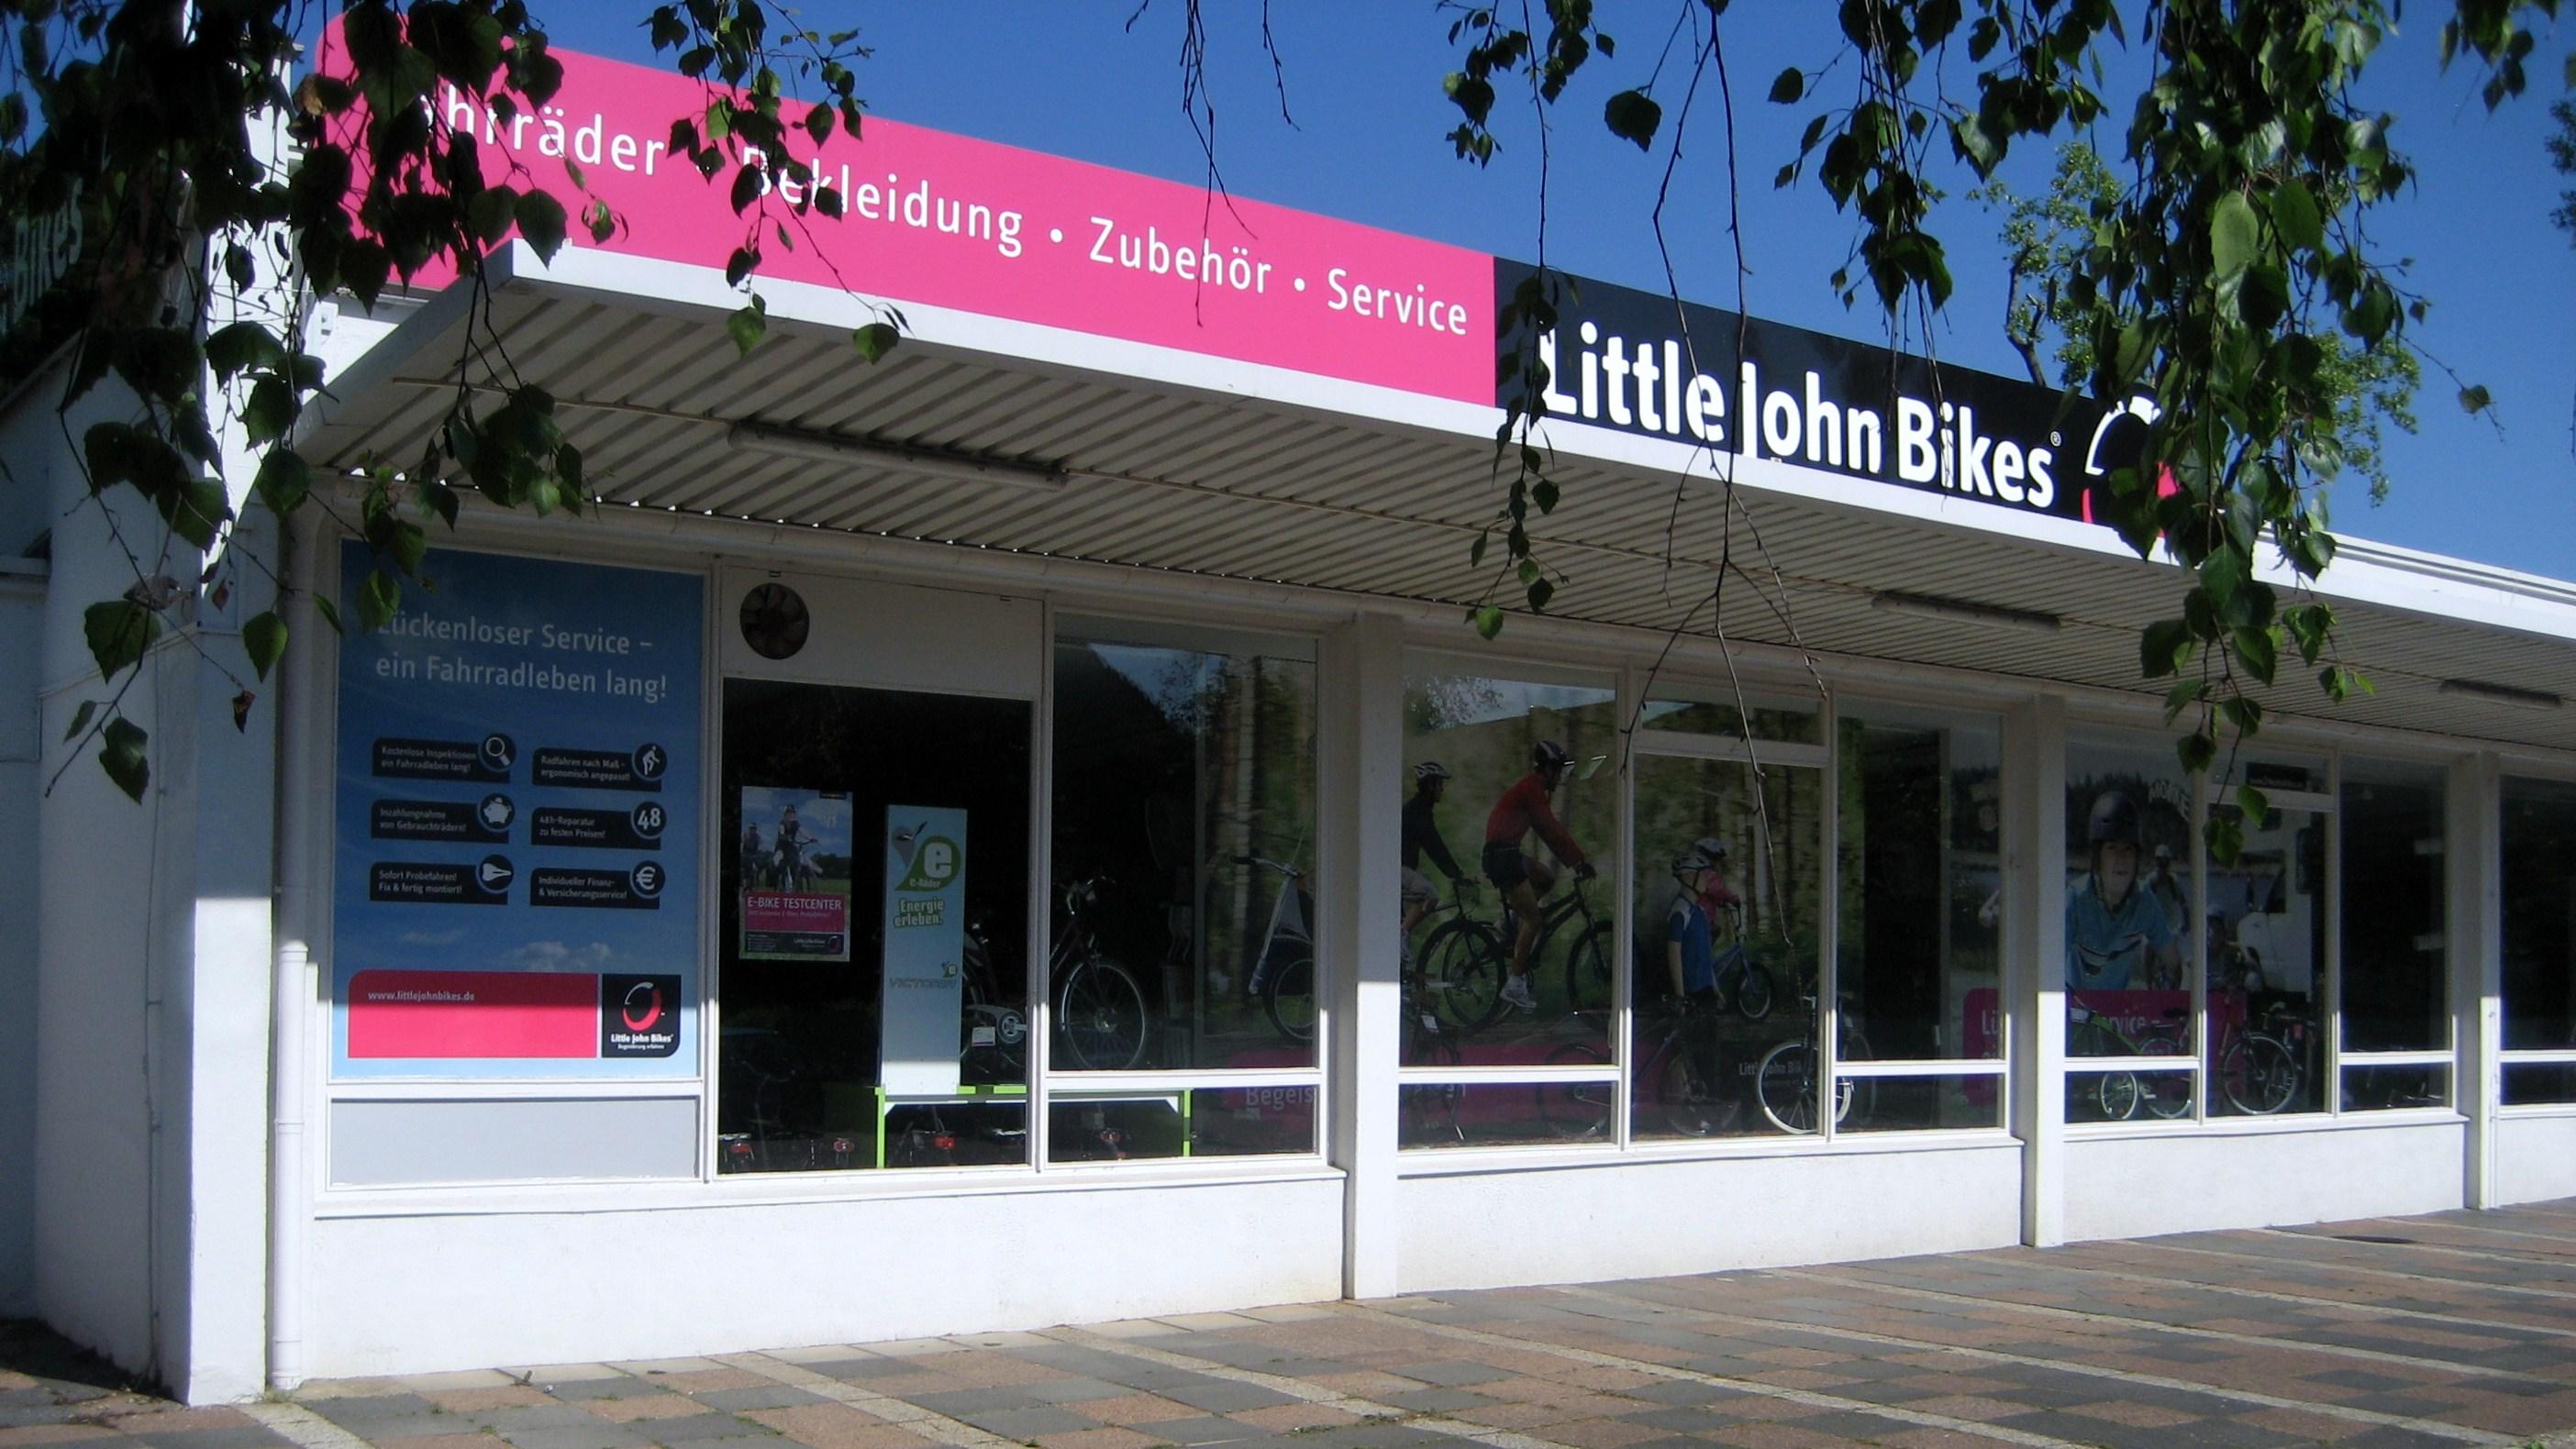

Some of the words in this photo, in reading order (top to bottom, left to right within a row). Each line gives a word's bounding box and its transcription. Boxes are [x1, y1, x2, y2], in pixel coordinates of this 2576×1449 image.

[417, 83, 665, 176] hrräder
[742, 147, 1024, 259] Bekleidung
[1089, 216, 1272, 294] Zubehör
[1327, 269, 1468, 336] Service
[1538, 321, 1725, 442] Little
[1741, 360, 1882, 474] John
[541, 625, 630, 654] Service
[375, 651, 416, 680] ein
[426, 655, 596, 693] Fahrradleben
[606, 669, 667, 703] lang!
[637, 807, 661, 830] 48
[748, 896, 781, 908] E-BIKE
[783, 898, 842, 911] TESTCENTER
[900, 896, 945, 914] Energie
[367, 990, 475, 1002] www.littlejohnbikes.de
[610, 1034, 630, 1043] Little
[632, 1034, 650, 1045] John
